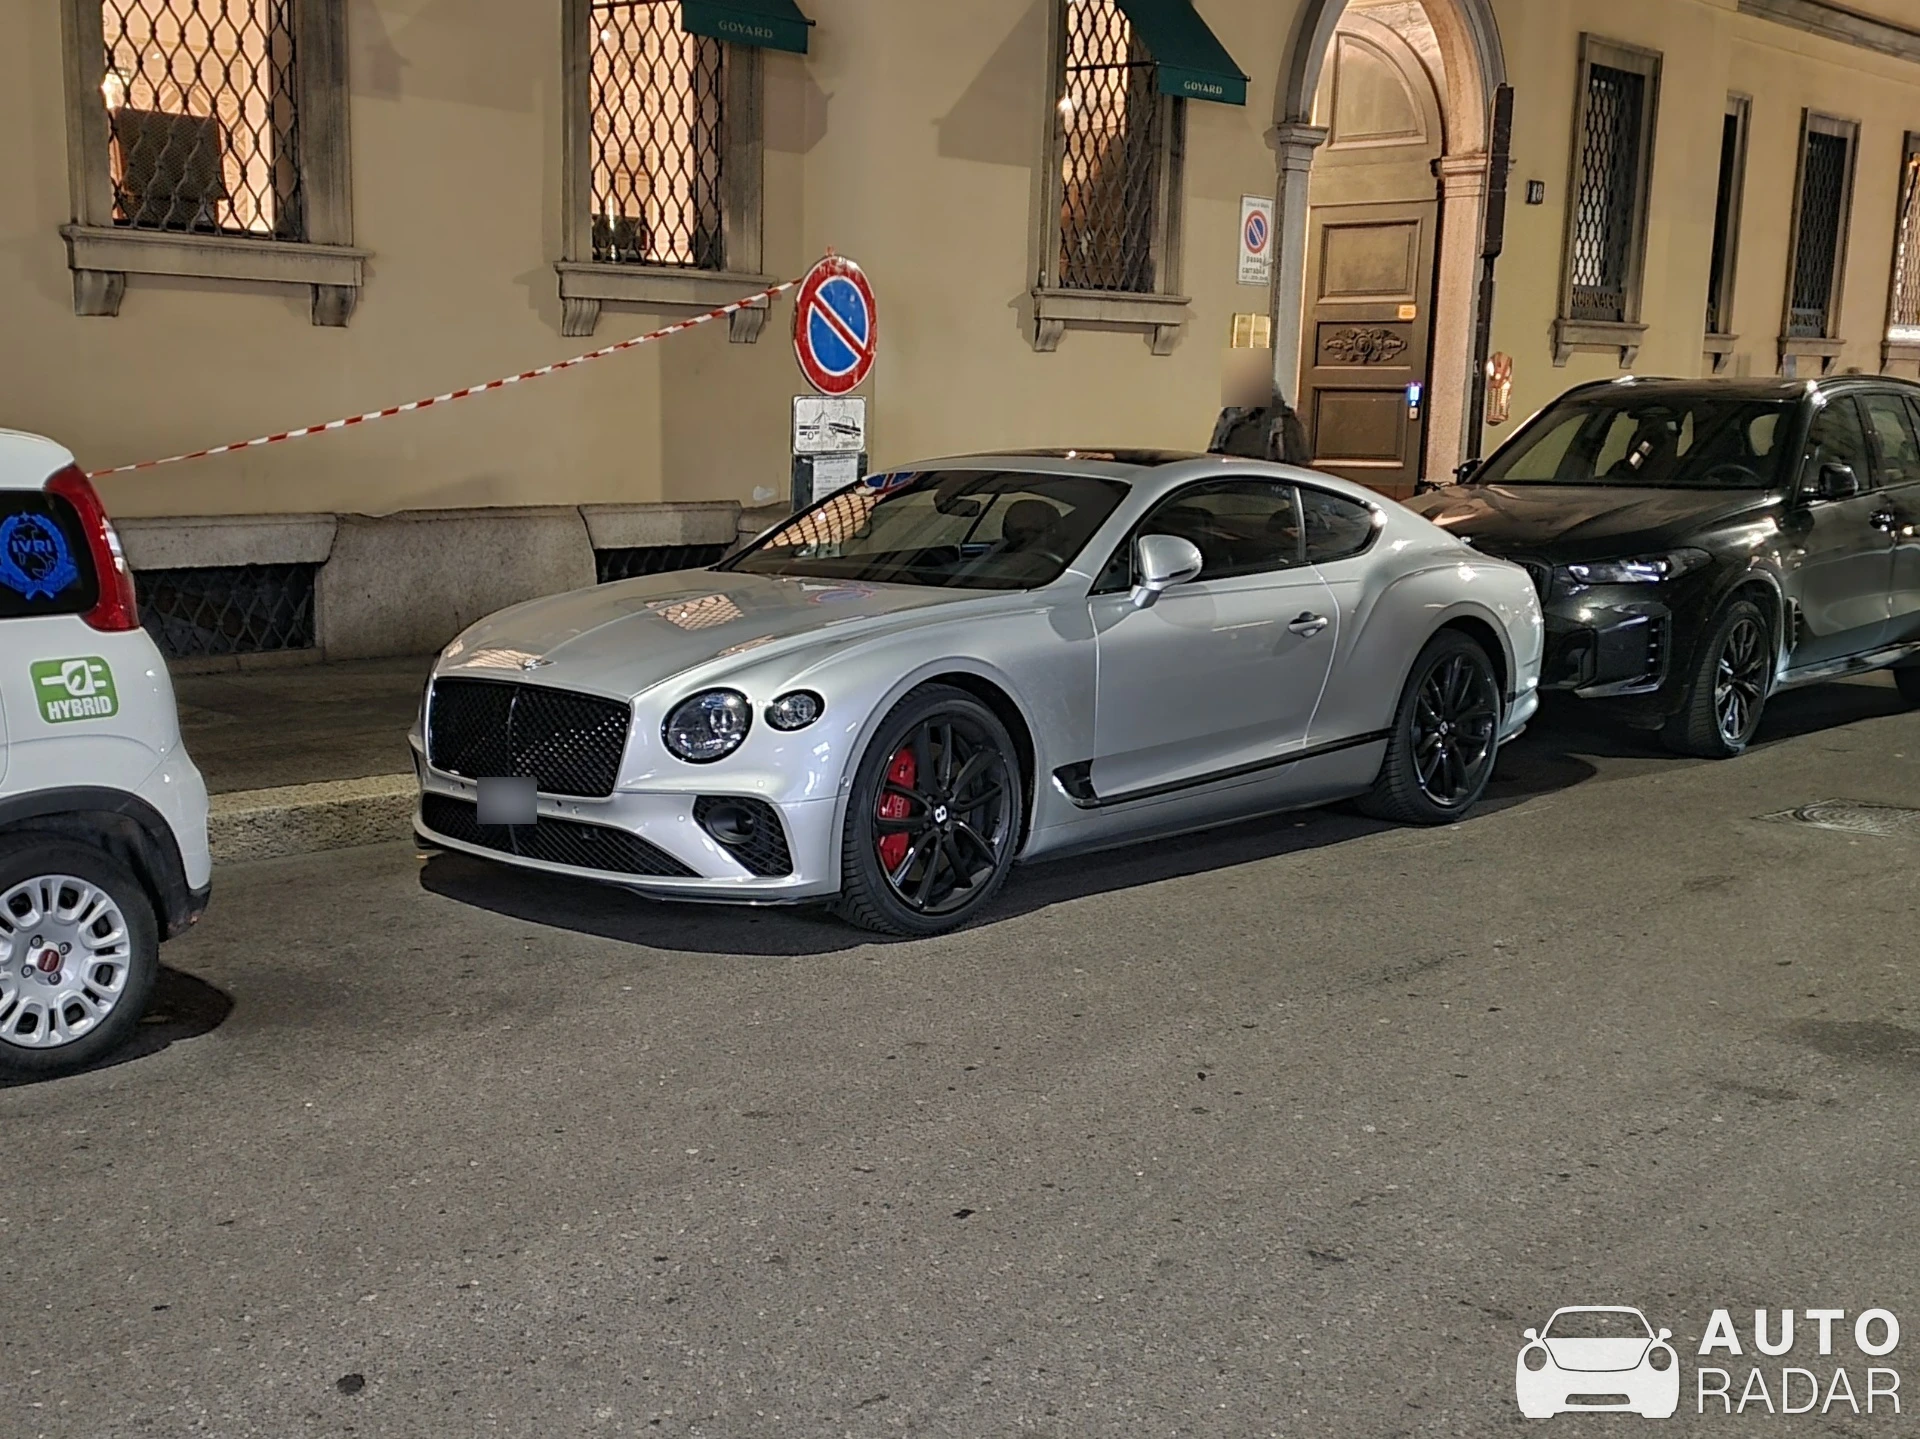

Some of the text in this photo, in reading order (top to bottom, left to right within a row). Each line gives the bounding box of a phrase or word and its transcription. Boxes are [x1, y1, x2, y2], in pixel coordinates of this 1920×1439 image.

[718, 20, 773, 38] GOYARD
[1184, 81, 1223, 94] GOYARD
[12, 540, 52, 552] IVRI
[47, 696, 112, 720] HYBRID
